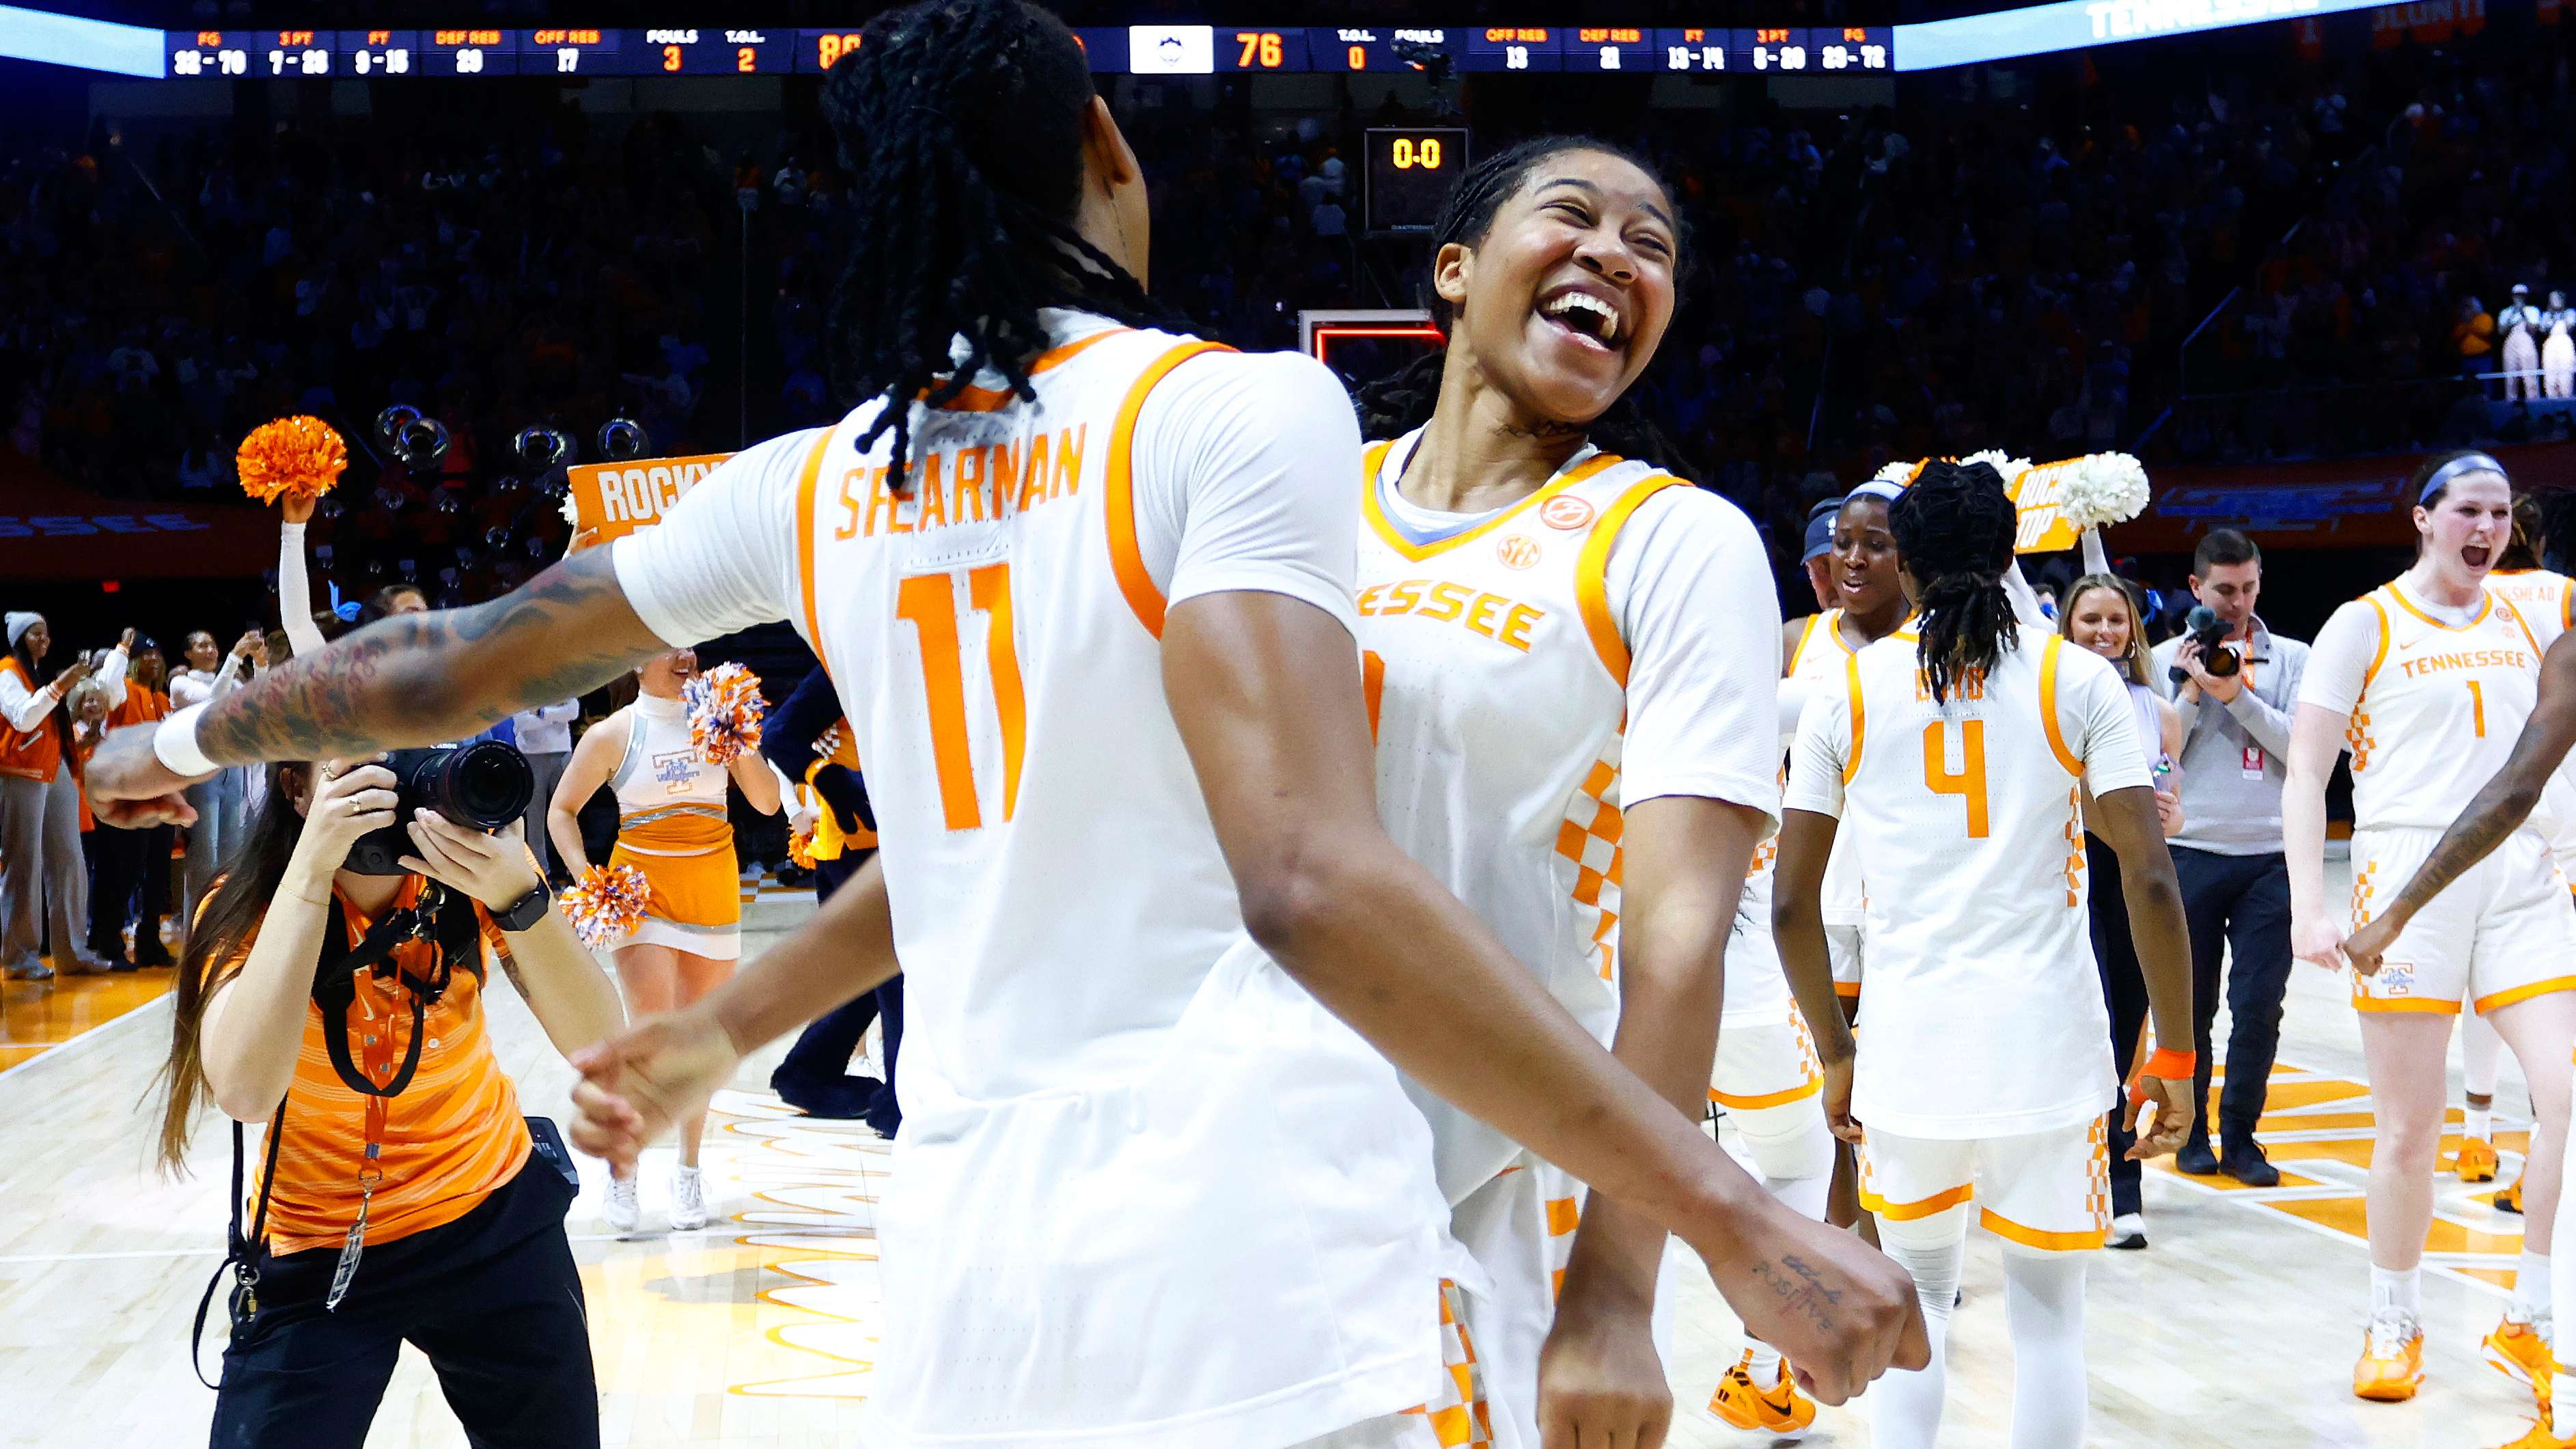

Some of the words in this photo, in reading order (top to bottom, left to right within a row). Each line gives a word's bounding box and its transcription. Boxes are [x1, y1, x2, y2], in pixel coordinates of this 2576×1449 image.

[197, 31, 221, 46] FG
[292, 31, 314, 45] PT
[368, 31, 390, 45] FT
[436, 31, 465, 44] DEF
[468, 30, 501, 44] REB
[534, 30, 566, 44] OFF
[568, 30, 600, 44] REB
[647, 29, 698, 43] FOULS
[1395, 29, 1443, 43] FOULS
[1486, 29, 1516, 42] OFF
[1517, 29, 1547, 42] REB
[1579, 29, 1609, 42] DEF
[1610, 29, 1641, 42] REB
[1685, 29, 1704, 42] FT
[1768, 29, 1789, 42] PT
[1844, 28, 1866, 42] FG
[557, 49, 579, 72] 17
[664, 46, 681, 71] 3
[738, 48, 756, 72] 2
[1236, 33, 1283, 67] 76
[1348, 46, 1366, 70] 0
[1506, 46, 1527, 68] 13
[1601, 46, 1620, 69] 21
[1393, 139, 1440, 169] 0.0
[1501, 536, 1539, 571] SEC
[1357, 579, 1546, 654] ESSEE
[2400, 650, 2526, 679] TENNESSEE
[2466, 680, 2486, 739] 1
[1923, 719, 1989, 838] 4
